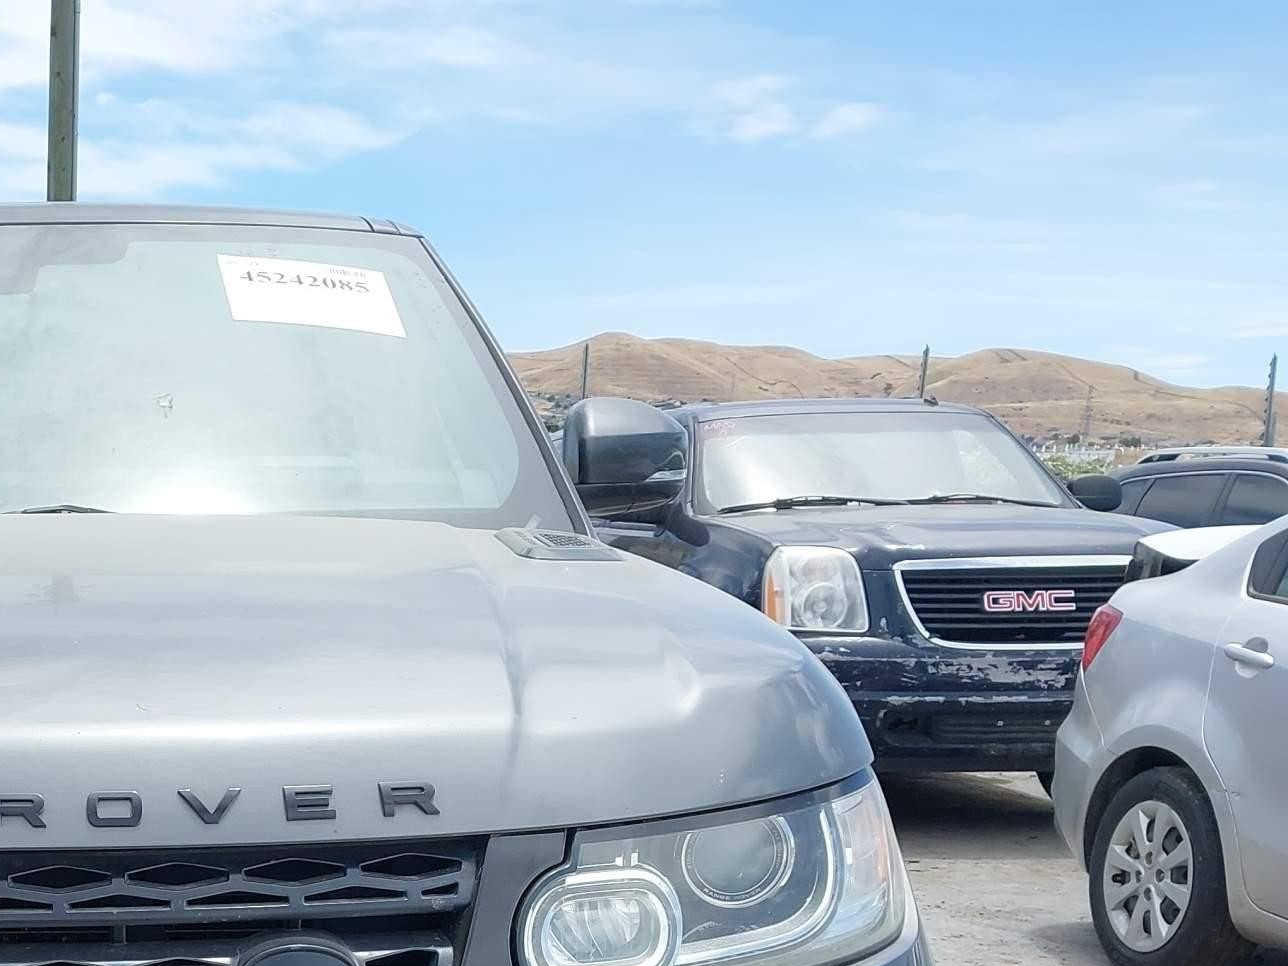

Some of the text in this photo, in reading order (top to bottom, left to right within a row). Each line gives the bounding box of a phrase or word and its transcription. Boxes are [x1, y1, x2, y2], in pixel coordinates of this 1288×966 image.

[240, 269, 370, 294] 45242085
[984, 589, 1077, 612] GMC
[703, 887, 731, 901] RANGE
